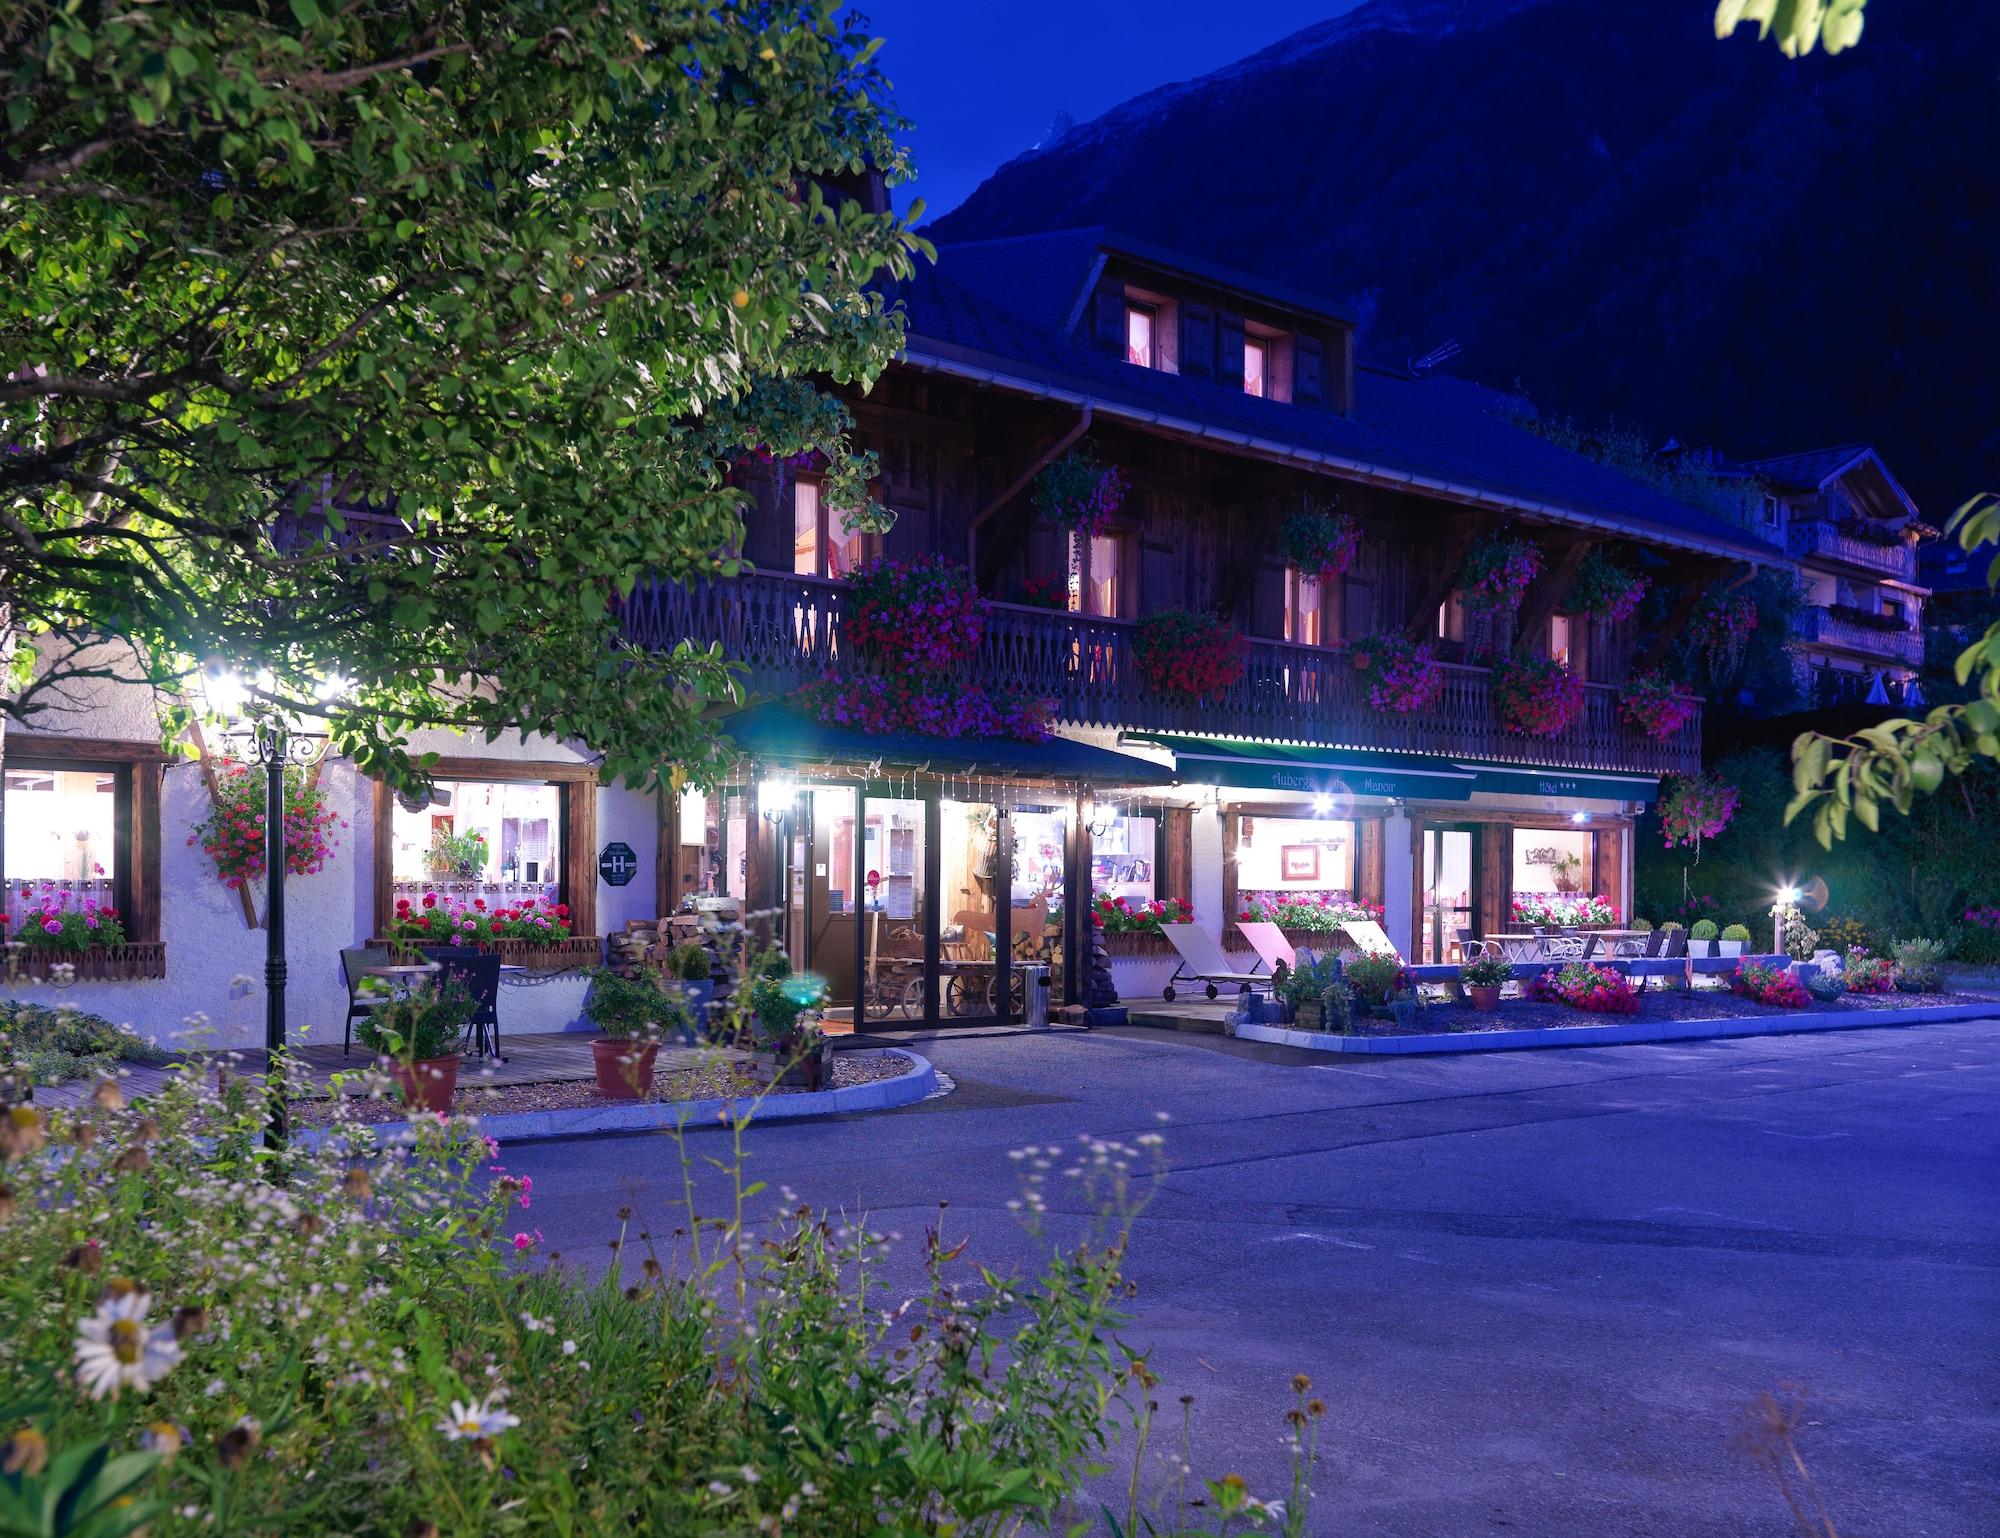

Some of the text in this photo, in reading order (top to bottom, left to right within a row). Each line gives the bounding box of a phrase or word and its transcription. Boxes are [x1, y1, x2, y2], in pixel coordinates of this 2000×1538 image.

[1272, 772, 1314, 790] Auberge
[1364, 778, 1396, 792] Manoir
[612, 856, 625, 873] H
